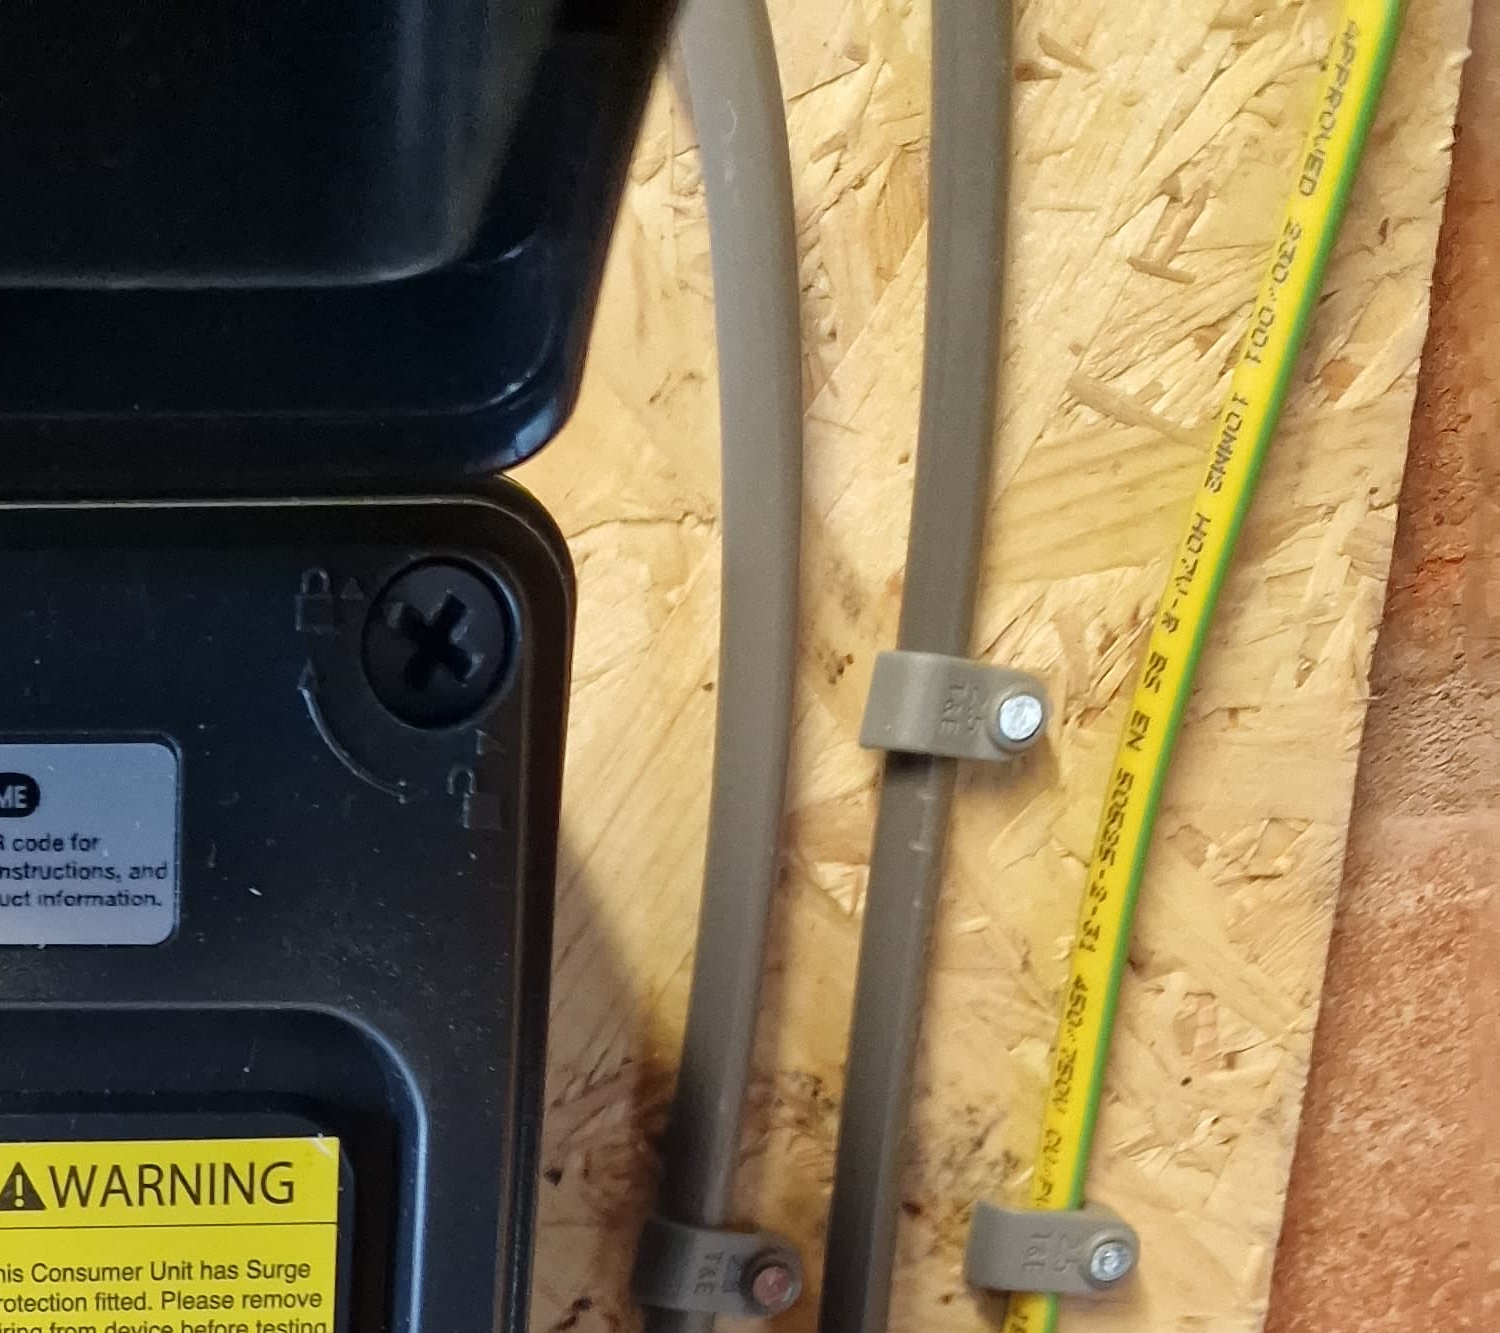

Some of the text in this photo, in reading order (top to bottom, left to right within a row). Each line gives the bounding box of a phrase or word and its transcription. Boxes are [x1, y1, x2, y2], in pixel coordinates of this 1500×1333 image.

[13, 833, 64, 852] code
[70, 833, 100, 852] for
[129, 861, 167, 880] and
[38, 890, 162, 908] information.
[49, 1161, 295, 1209] WARNING
[31, 1262, 142, 1283] Consumer
[150, 1261, 192, 1281] Unit
[200, 1260, 238, 1281] has
[247, 1260, 311, 1284] Surge
[95, 1291, 153, 1312] fitted.
[161, 1291, 235, 1311] Please
[242, 1294, 323, 1309] remove
